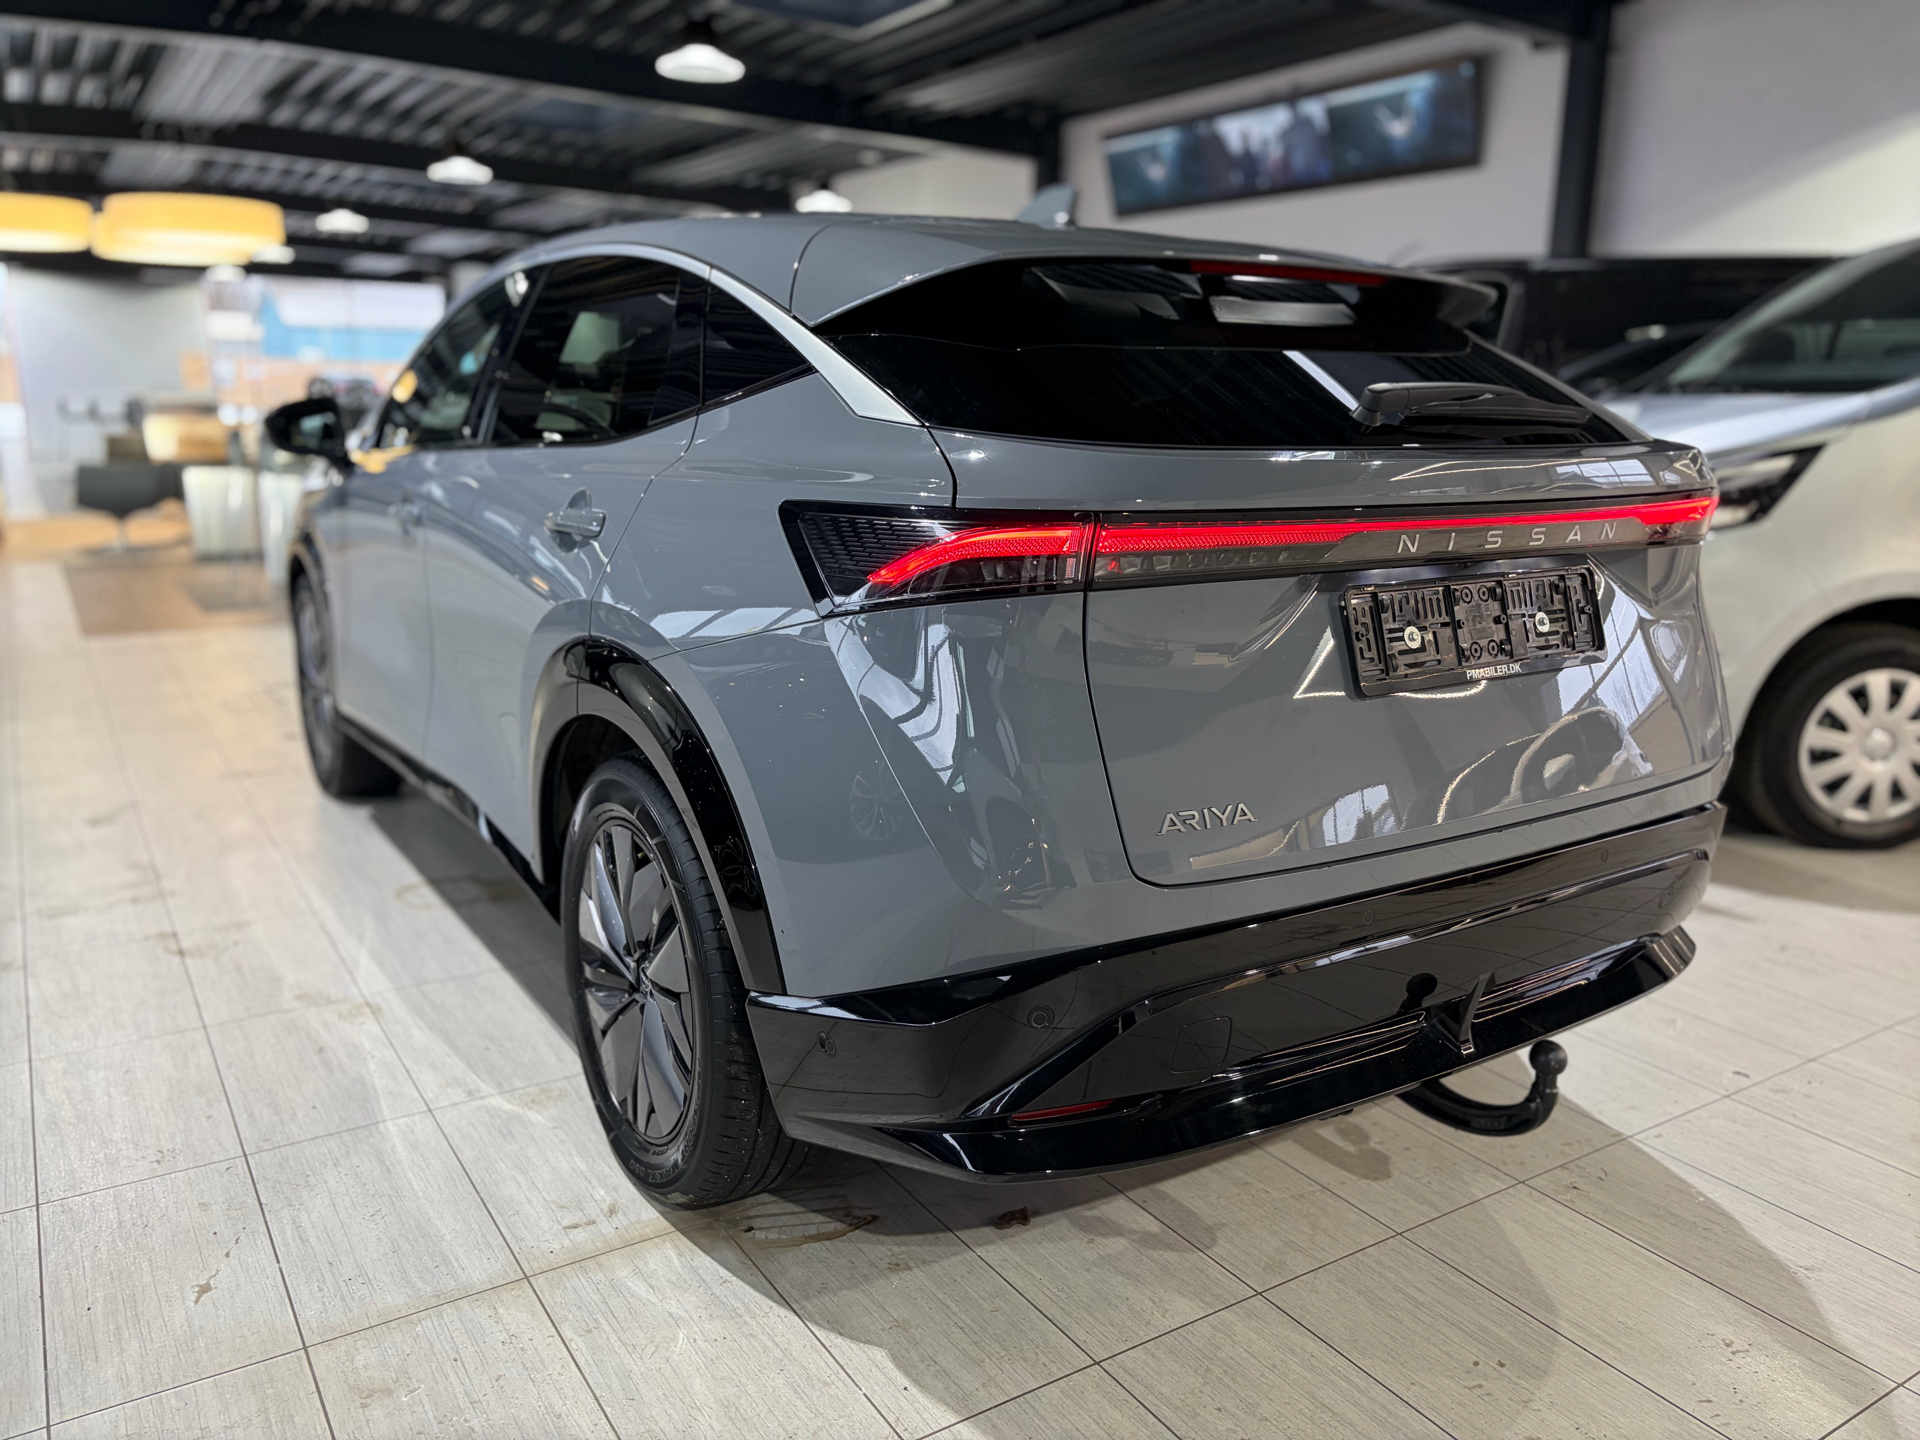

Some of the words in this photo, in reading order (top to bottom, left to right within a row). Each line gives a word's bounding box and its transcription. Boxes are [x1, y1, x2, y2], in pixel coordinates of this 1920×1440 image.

[1397, 522, 1617, 553] NISSAN
[1466, 661, 1522, 680] PMABILER.DK
[1156, 802, 1259, 836] ARIYA
[647, 1159, 680, 1183] MAXX
